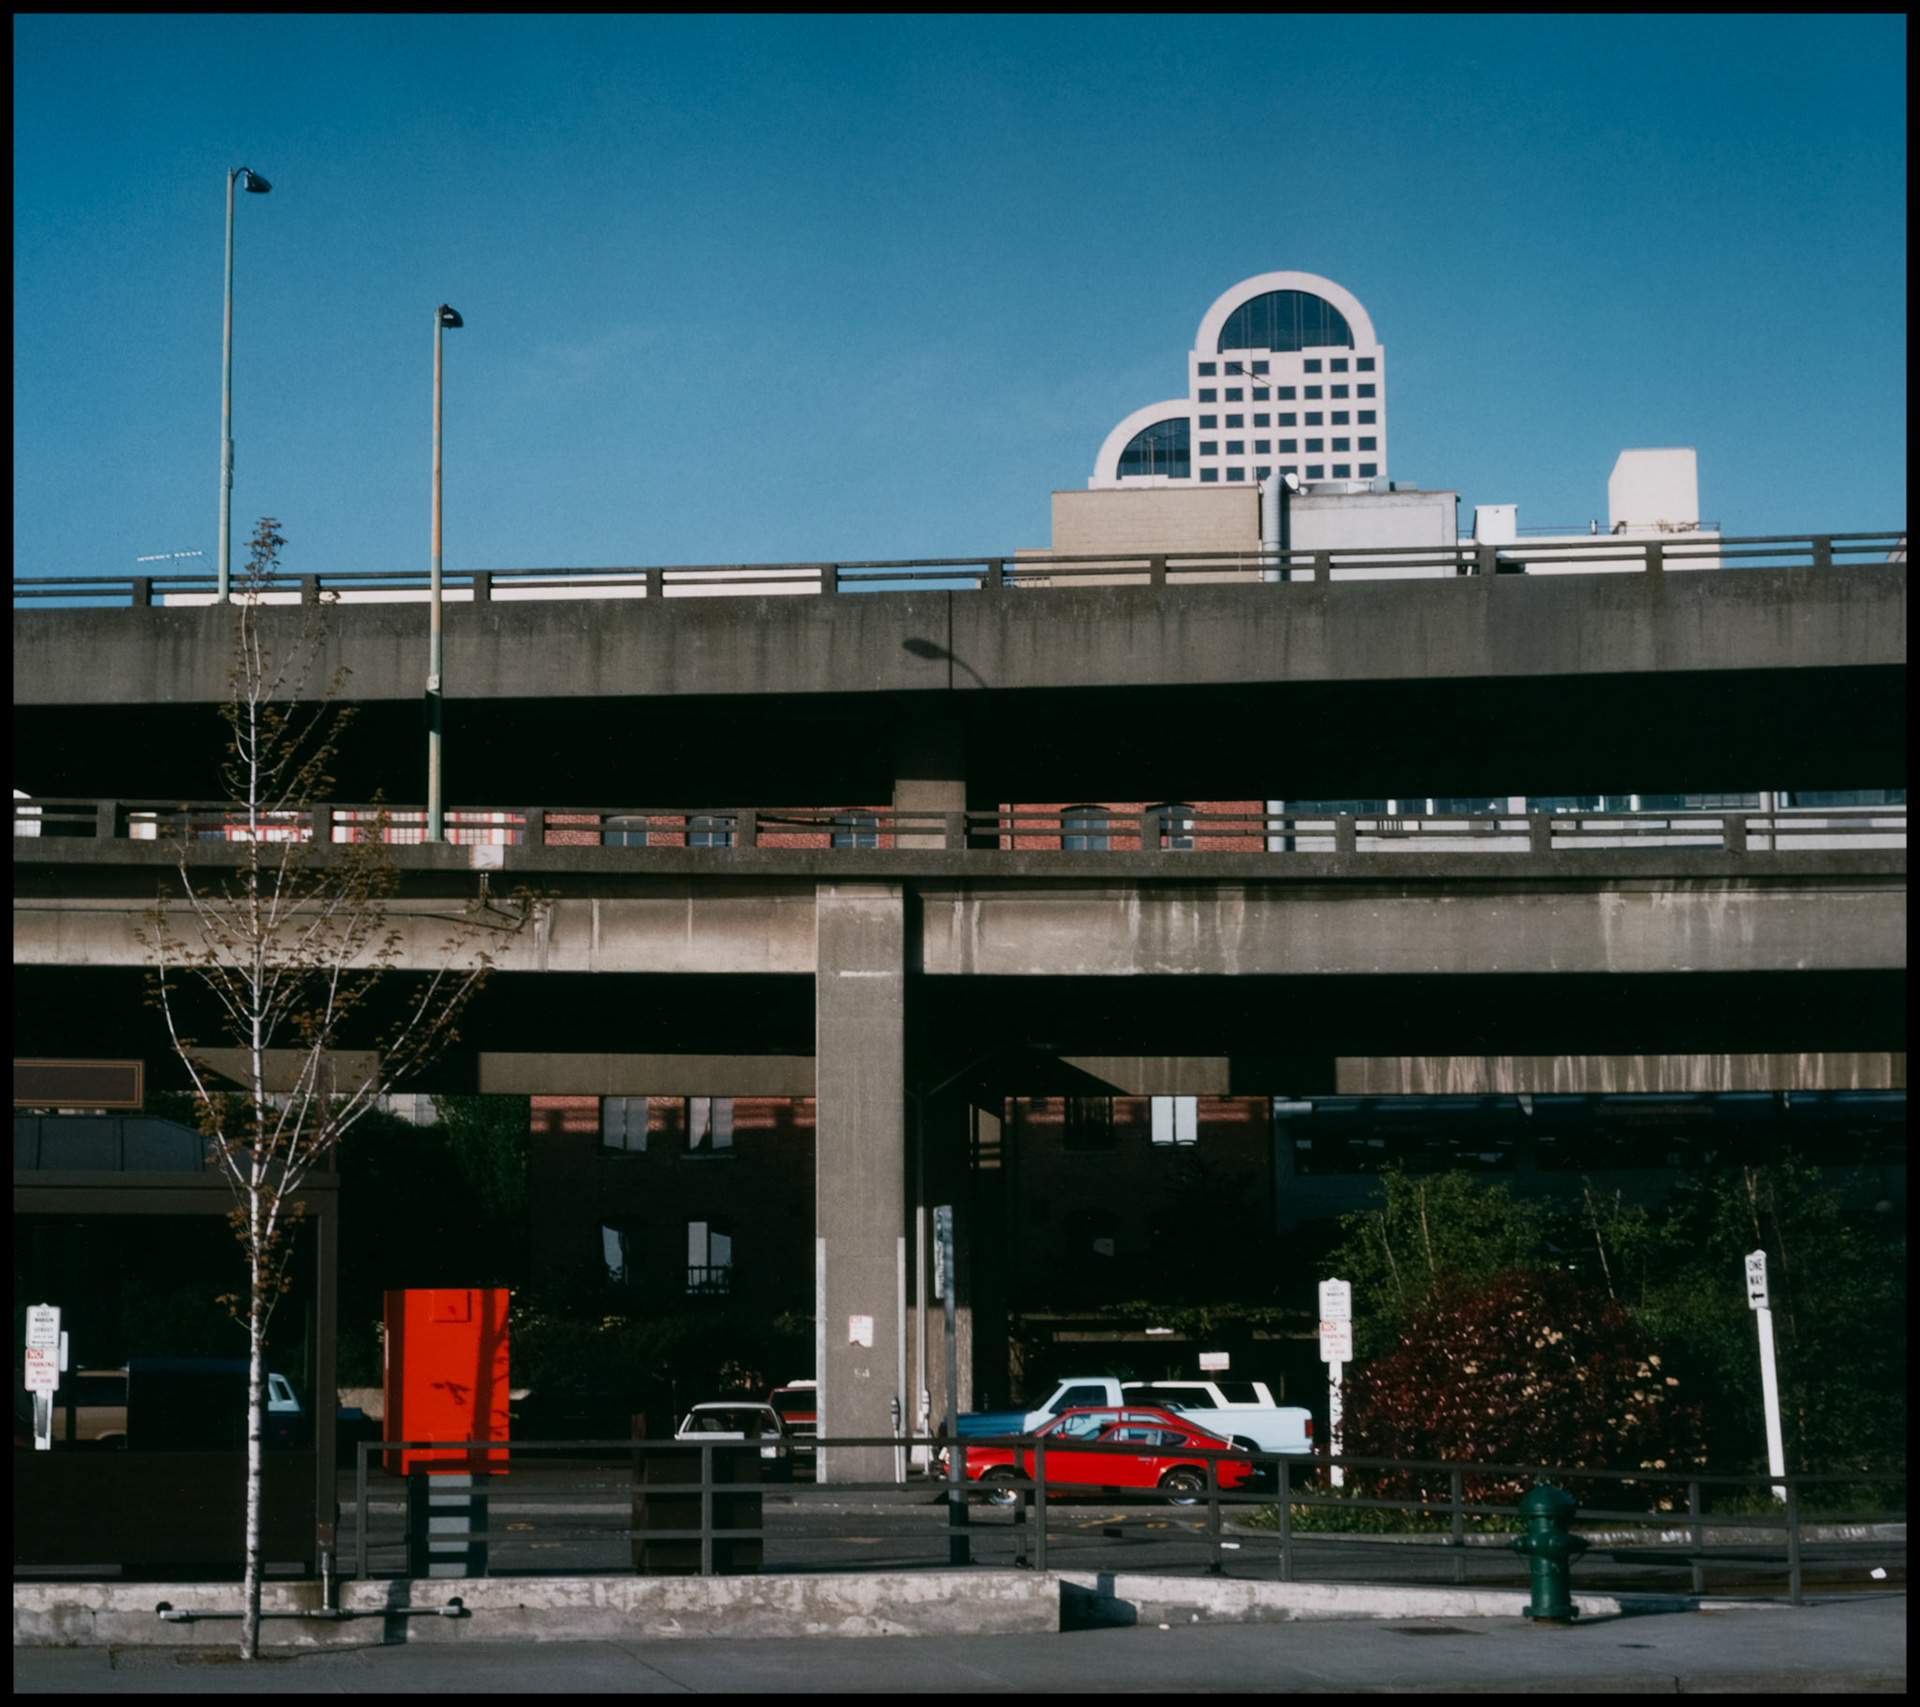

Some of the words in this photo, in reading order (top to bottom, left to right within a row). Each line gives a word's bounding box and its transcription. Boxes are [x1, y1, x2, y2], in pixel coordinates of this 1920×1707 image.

[1748, 1258, 1762, 1271] ONE
[1749, 1275, 1762, 1285] WAY
[27, 1349, 44, 1359] NO
